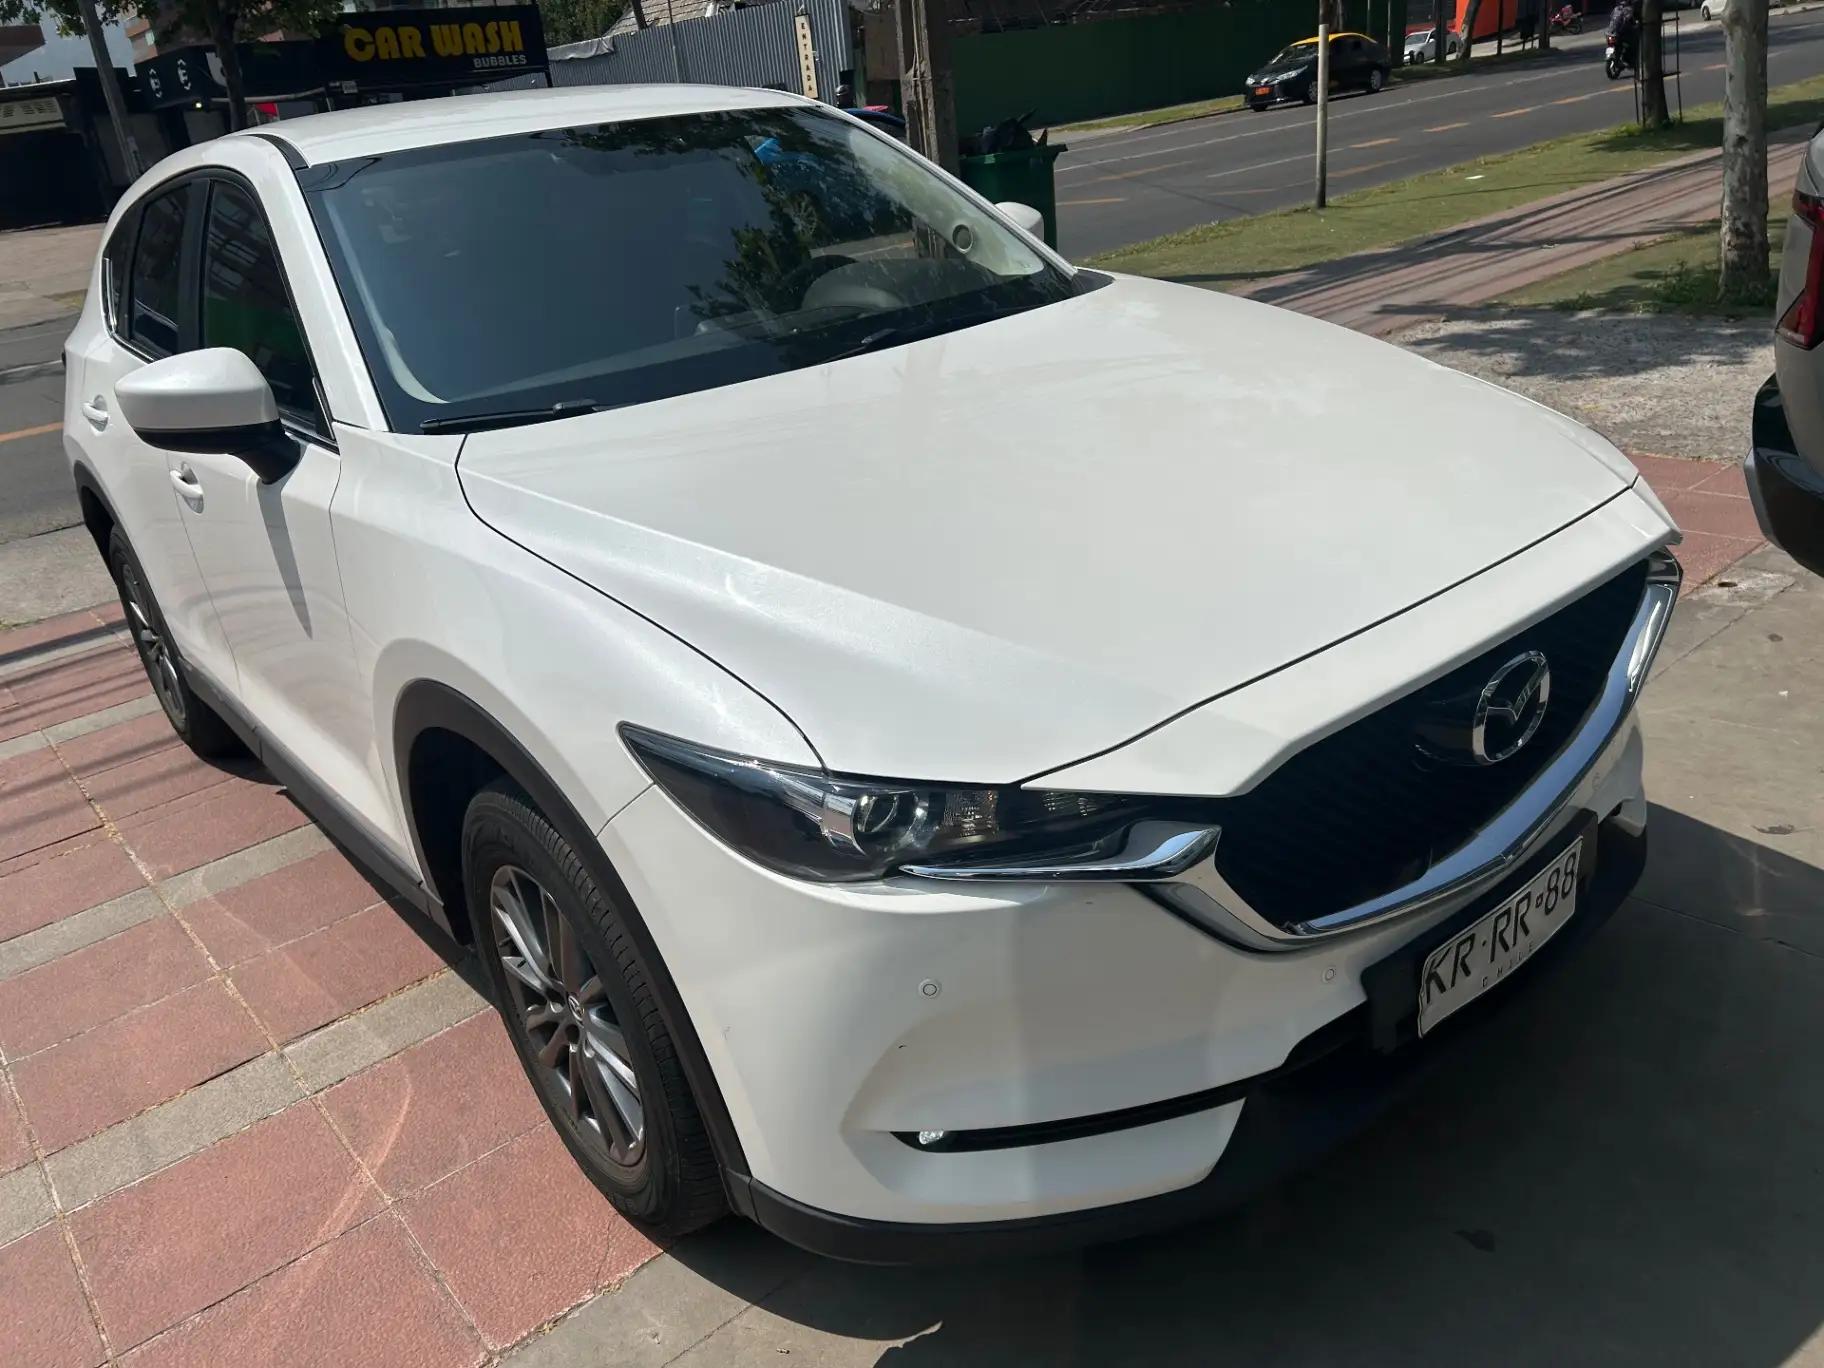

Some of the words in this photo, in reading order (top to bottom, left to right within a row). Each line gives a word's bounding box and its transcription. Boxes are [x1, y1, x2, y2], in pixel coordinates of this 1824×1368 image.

[344, 25, 426, 62] CAR
[429, 21, 524, 57] WASH
[473, 54, 527, 69] BUBBLES
[801, 22, 813, 92] ENTRADA
[1482, 943, 1534, 988] CHILE
